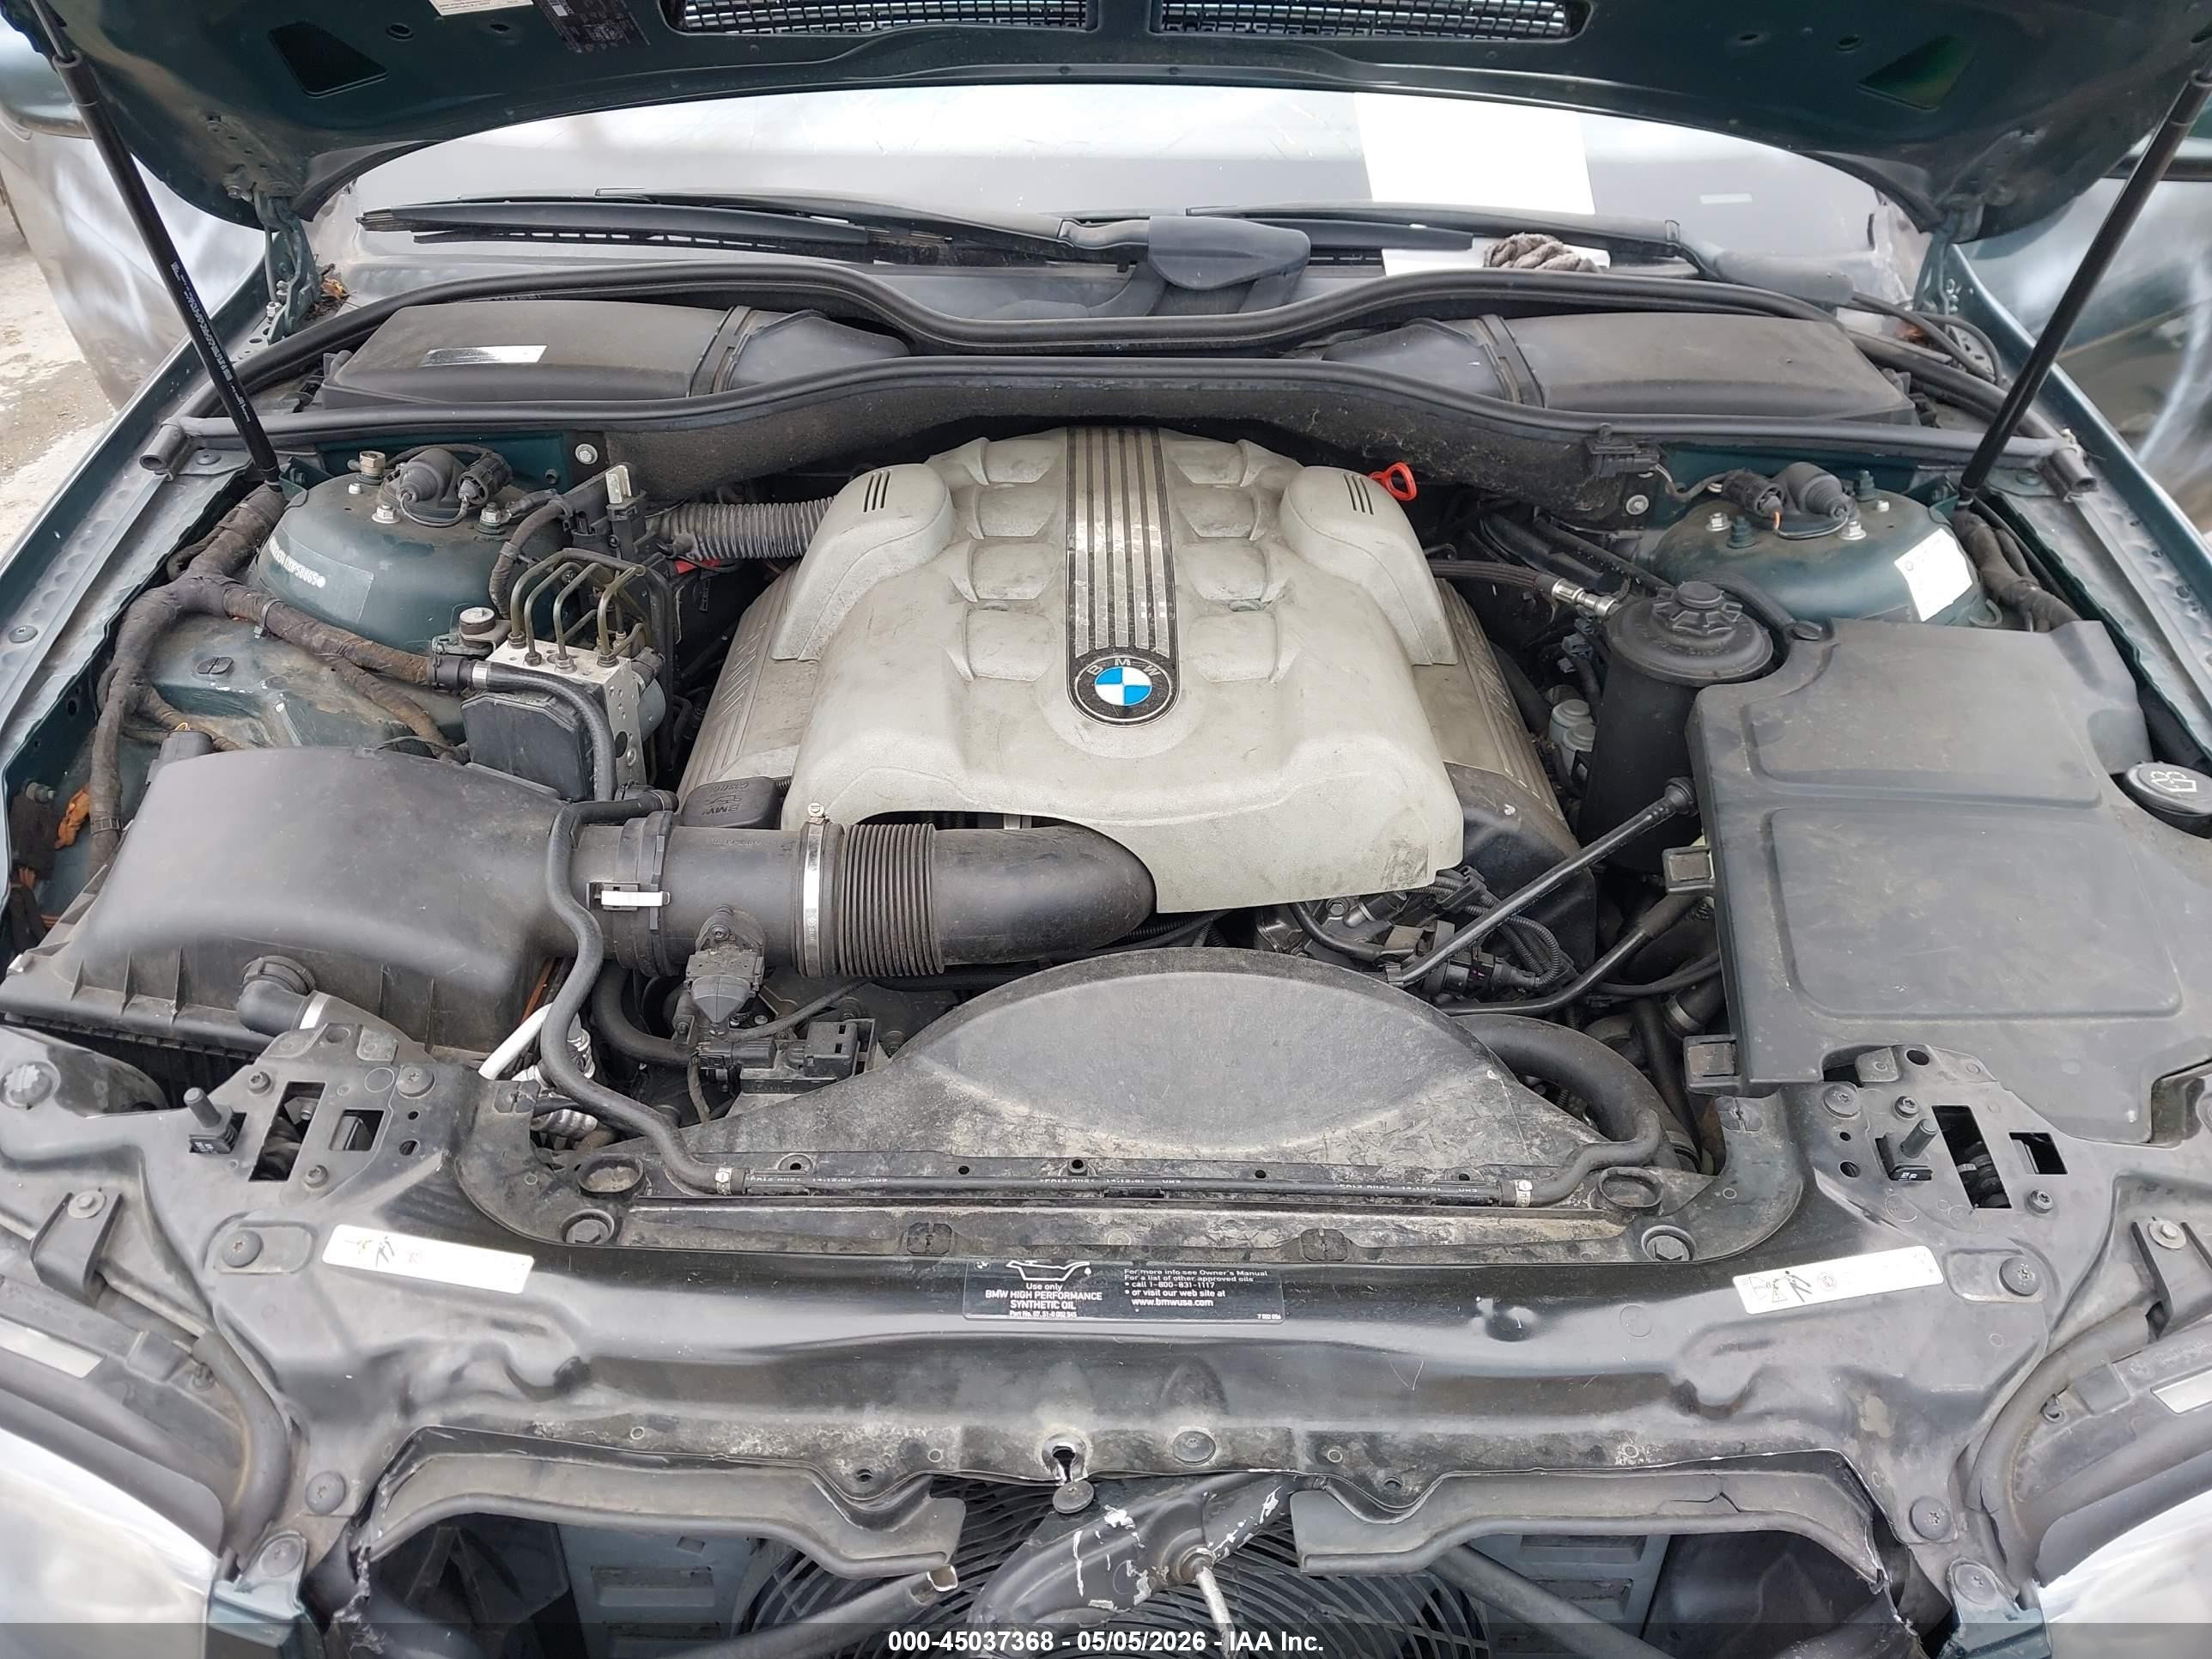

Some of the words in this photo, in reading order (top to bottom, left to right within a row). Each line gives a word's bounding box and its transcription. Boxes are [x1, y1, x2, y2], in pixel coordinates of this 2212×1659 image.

[1086, 658, 1162, 677] BMW
[1044, 1283, 1064, 1292] only
[985, 1290, 1008, 1298] BMW
[1010, 1290, 1033, 1299] HIGH
[1034, 1291, 1103, 1301] PERFORMANCE
[1010, 1299, 1060, 1310] SYNTHETIC
[1060, 1300, 1077, 1310] OIL
[1131, 1297, 1214, 1307] www.bmwusa.com
